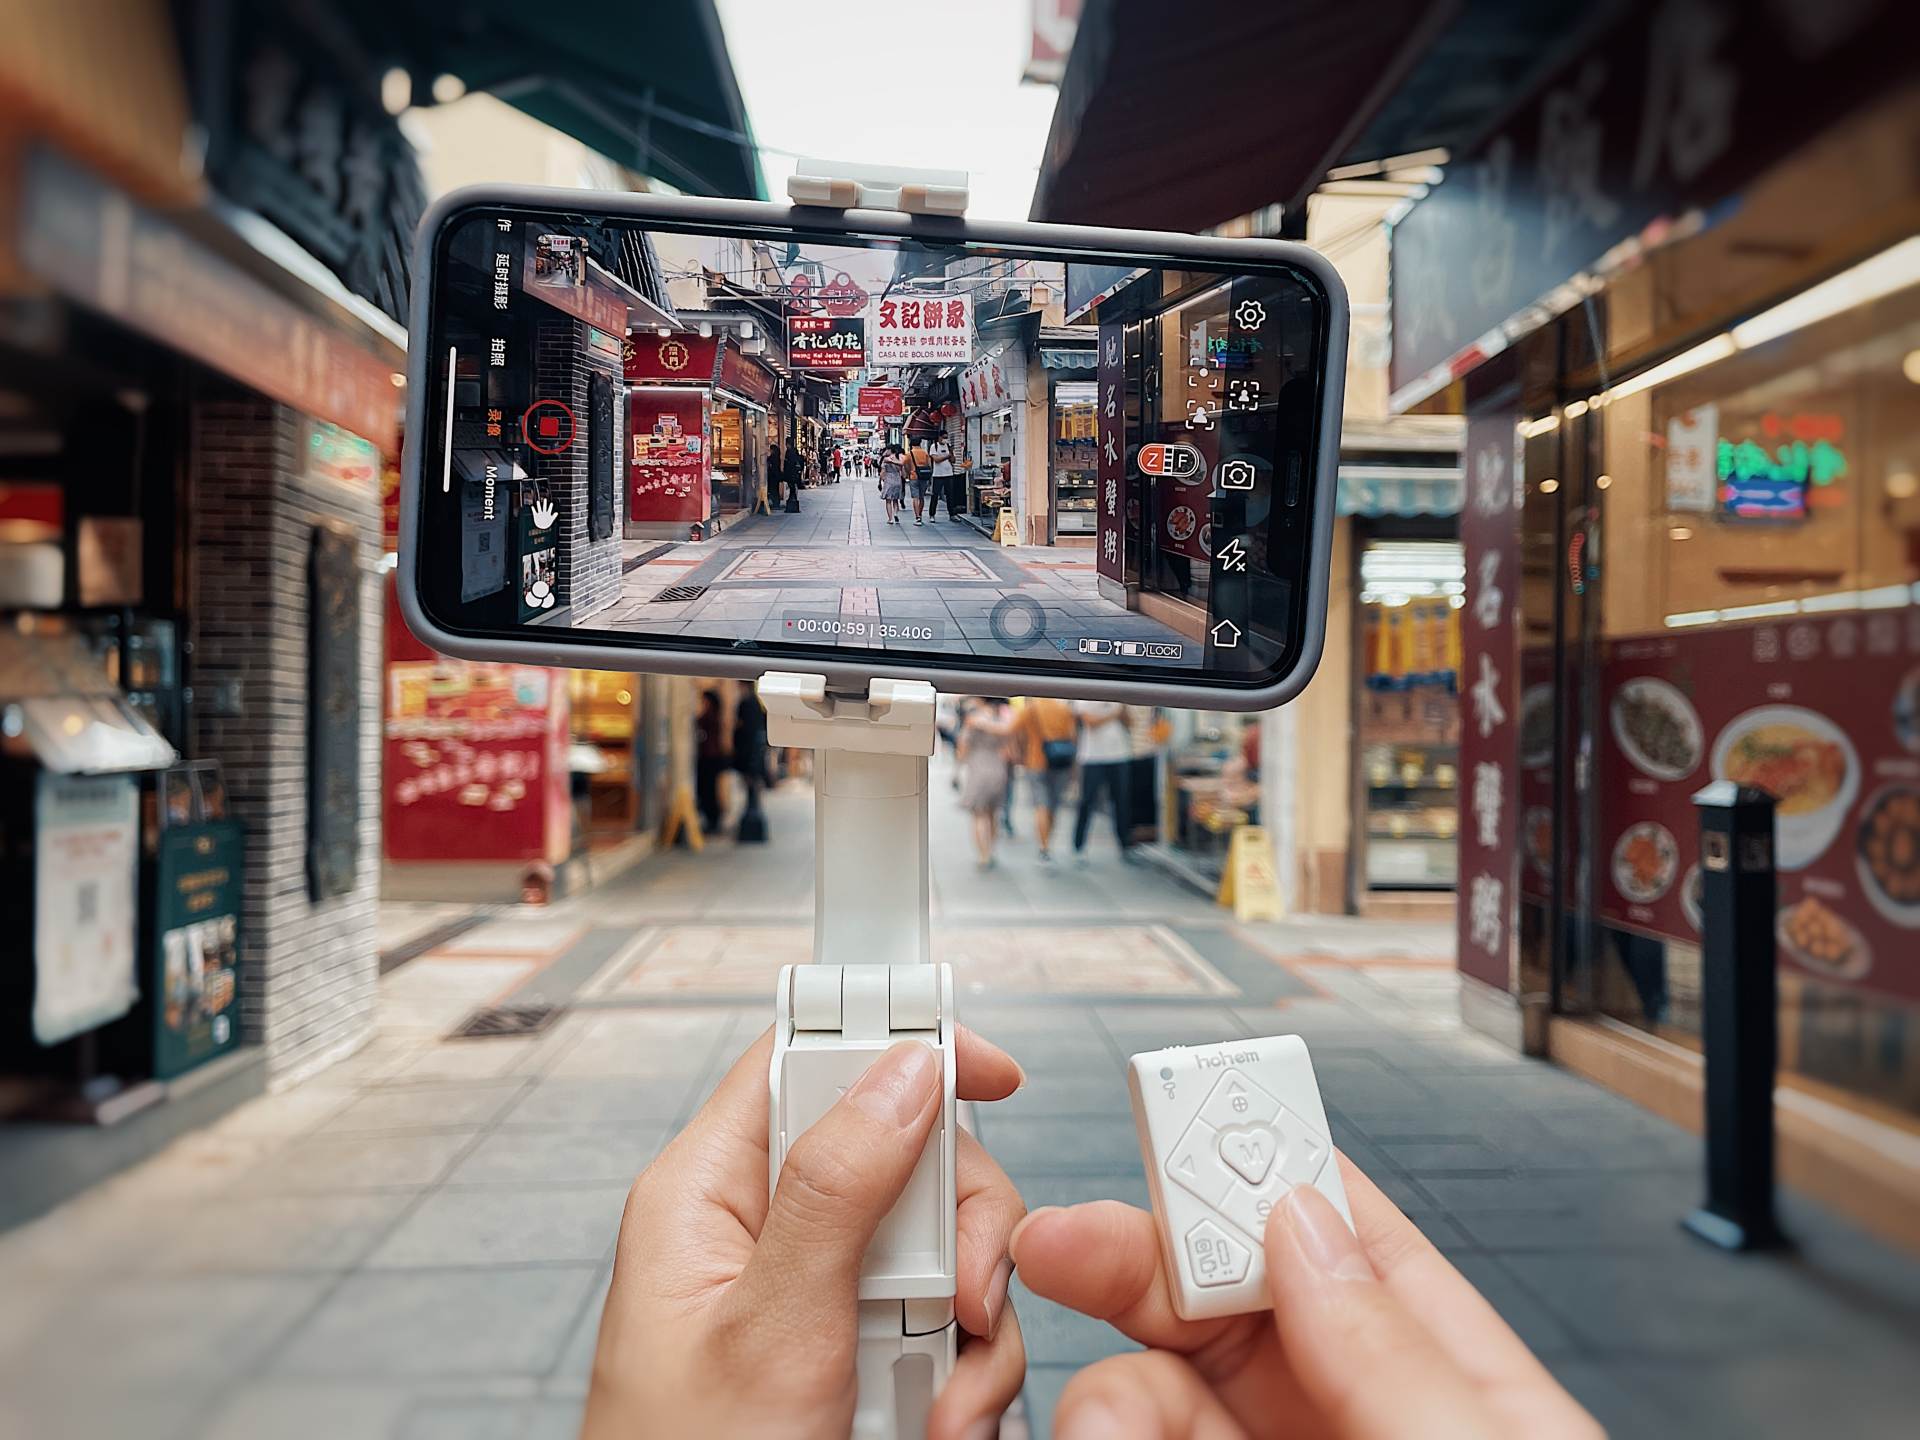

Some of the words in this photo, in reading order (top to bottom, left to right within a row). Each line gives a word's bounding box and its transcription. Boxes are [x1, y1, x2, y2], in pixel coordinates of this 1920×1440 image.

[494, 253, 509, 309] 延时摄影
[879, 301, 964, 329] 文記餅家
[792, 331, 861, 350] 香記肉乾
[491, 339, 506, 367] 拍照
[488, 409, 502, 436] 录像
[1147, 453, 1158, 467] Z
[1178, 454, 1188, 468] F
[484, 466, 498, 520] Moment
[798, 619, 865, 635] 00:00:59
[879, 625, 932, 639] 35.40G
[1150, 646, 1178, 656] LOCK
[1193, 1051, 1260, 1069] hohem
[1239, 1141, 1264, 1165] M
